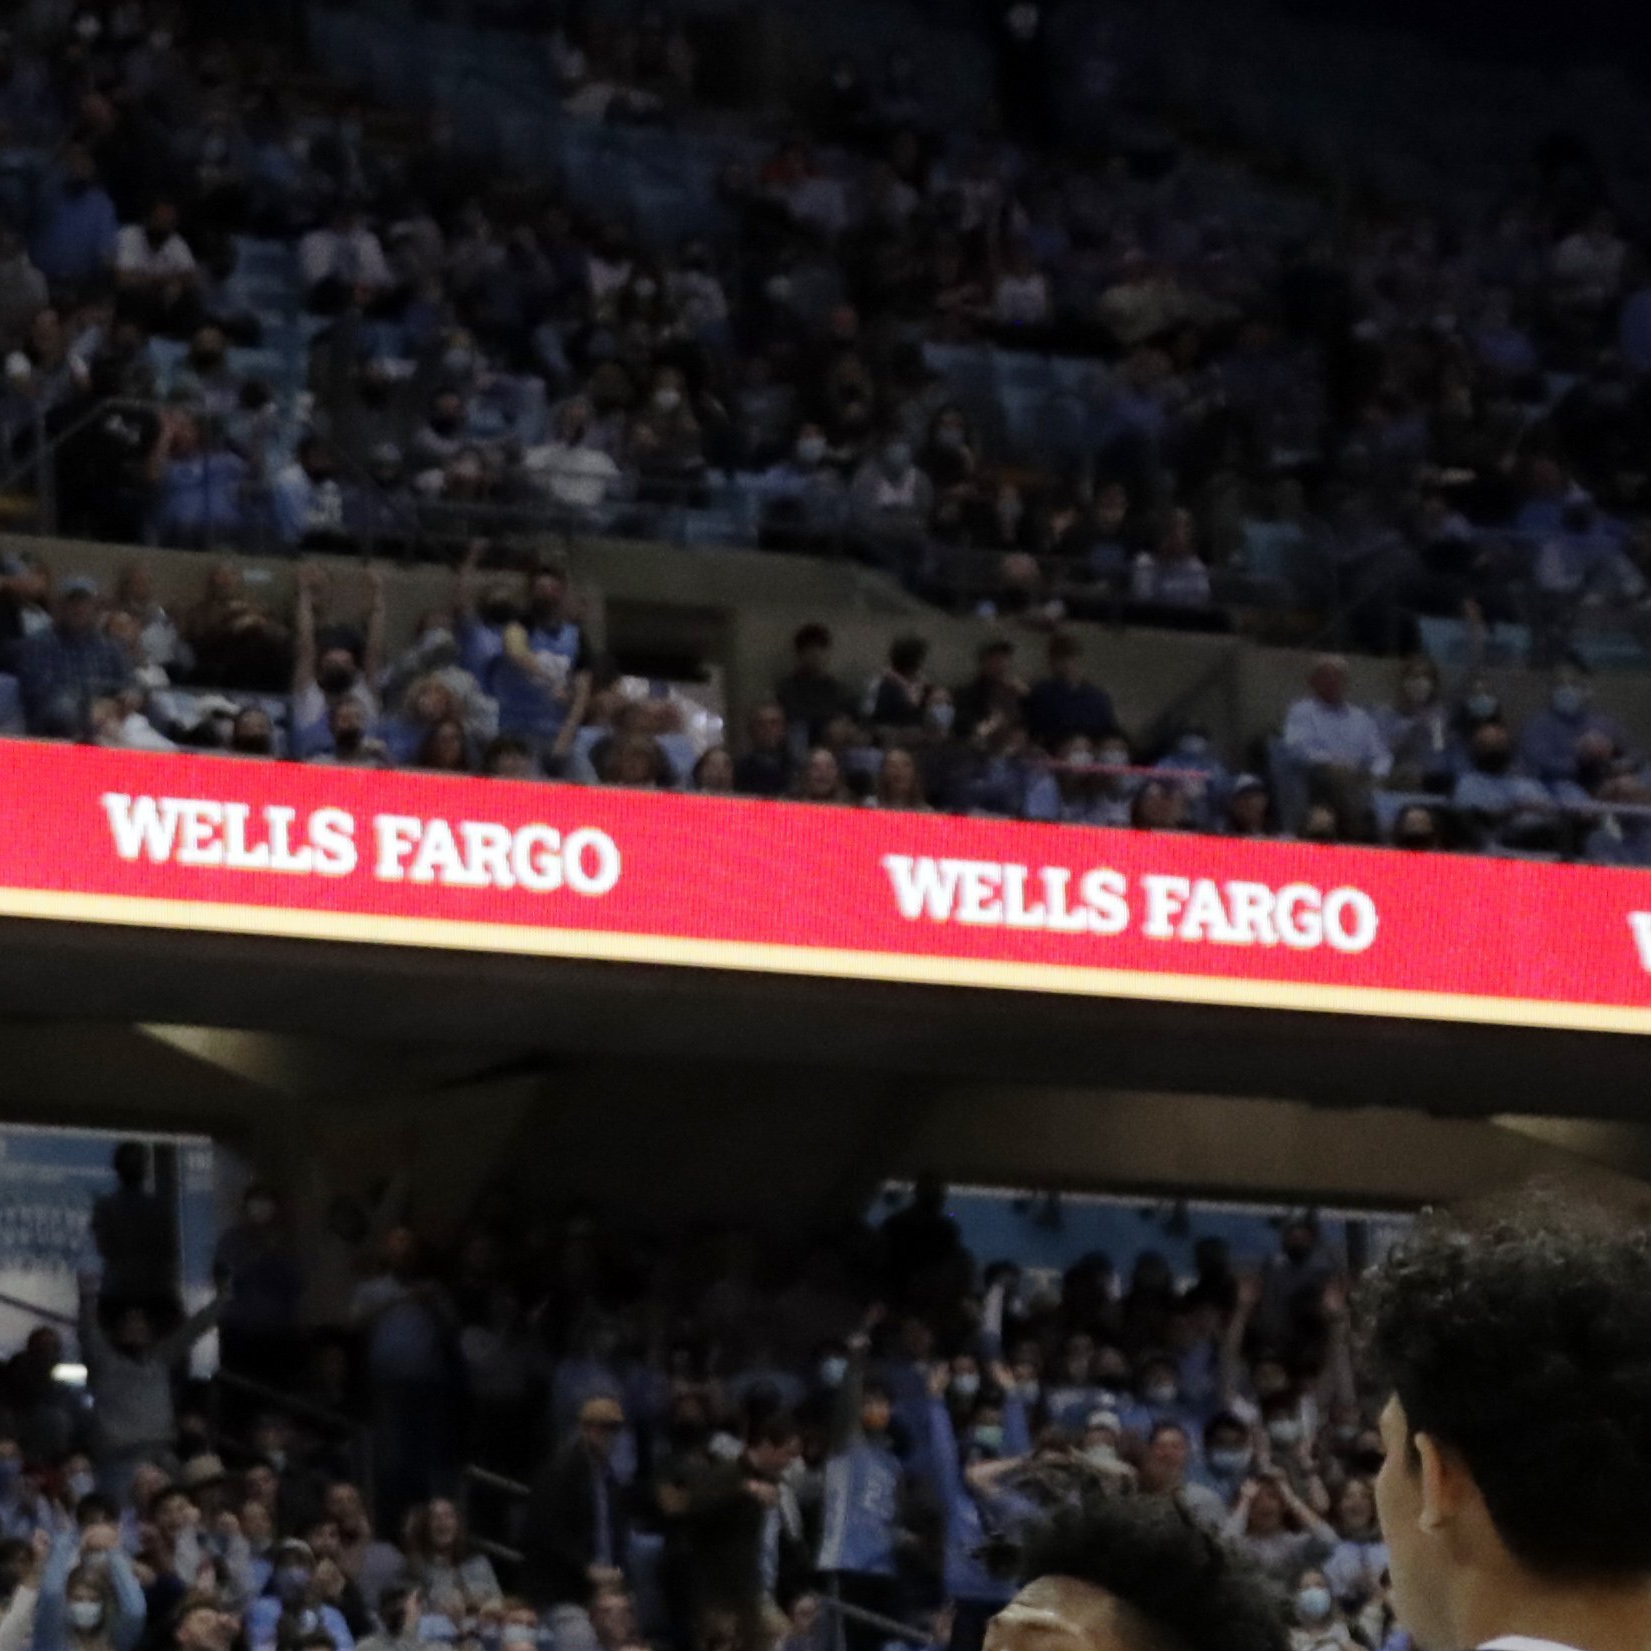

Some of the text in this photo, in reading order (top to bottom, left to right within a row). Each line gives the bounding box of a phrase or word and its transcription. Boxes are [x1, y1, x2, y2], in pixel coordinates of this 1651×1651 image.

[102, 792, 621, 894] WELLS FARGO
[884, 854, 1379, 951] WELLS FARGO
